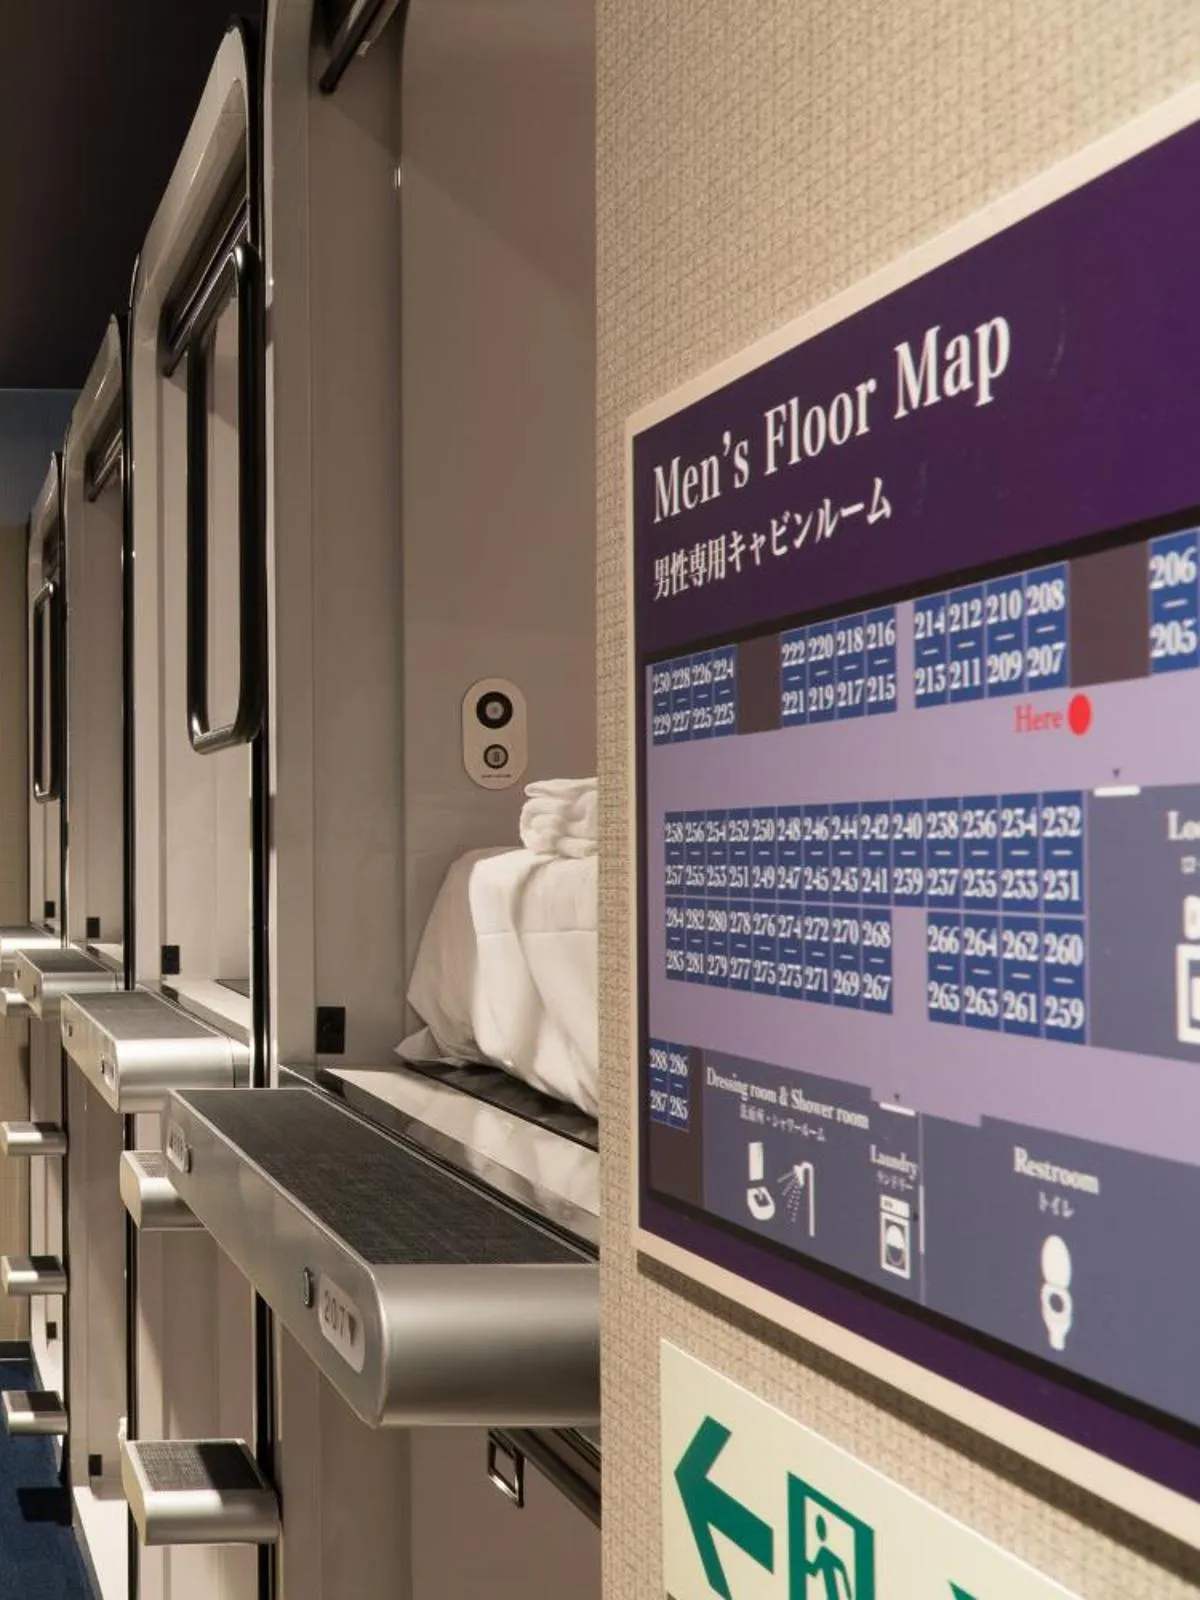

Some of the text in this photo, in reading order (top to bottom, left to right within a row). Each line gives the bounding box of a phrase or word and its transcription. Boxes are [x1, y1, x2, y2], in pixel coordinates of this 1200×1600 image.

[653, 315, 1012, 524] Men's Floor Map
[654, 476, 892, 601] 男性専用キャビンルーム
[782, 641, 805, 667] 222
[808, 635, 833, 662] 220
[837, 627, 864, 656] 218
[867, 619, 896, 649] 216
[915, 606, 945, 640] 214
[950, 599, 982, 632] 212
[986, 589, 1022, 625] 210
[1027, 579, 1065, 615] 208
[1149, 546, 1197, 590] 206
[783, 691, 804, 716] 221
[808, 685, 833, 711] 219
[838, 679, 865, 707] 217
[868, 674, 896, 702] 215
[915, 664, 946, 694] 213
[950, 658, 981, 690] 211
[987, 650, 1023, 683] 209
[1027, 643, 1066, 677] 207
[1151, 619, 1197, 658] 205
[1014, 704, 1062, 733] Here
[729, 820, 749, 843] 252
[752, 819, 774, 843] 250
[778, 817, 800, 841] 248
[804, 816, 828, 841] 246
[832, 815, 859, 841] 244
[862, 814, 889, 840] 242
[892, 813, 922, 840] 240
[927, 811, 958, 839] 238
[962, 810, 997, 838] 236
[1002, 807, 1038, 838] 234
[1042, 806, 1081, 837] 232
[729, 866, 749, 888] 251
[753, 866, 774, 888] 249
[778, 867, 800, 889] 247
[805, 867, 828, 891] 245
[832, 867, 859, 892] 243
[862, 868, 888, 893] 241
[894, 868, 922, 894] 239
[928, 868, 958, 896] 237
[964, 868, 997, 898] 235
[1002, 869, 1038, 900] 233
[1044, 869, 1080, 901] 231
[730, 912, 751, 935] 278
[753, 913, 775, 936] 276
[779, 914, 802, 939] 274
[805, 917, 829, 942] 272
[833, 919, 859, 945] 270
[863, 921, 890, 947] 268
[928, 925, 960, 955] 266
[964, 927, 997, 957] 264
[1002, 930, 1038, 962] 262
[1044, 934, 1082, 966] 260
[707, 955, 727, 977] 279
[730, 957, 751, 980] 277
[753, 960, 776, 984] 275
[779, 962, 802, 988] 273
[805, 966, 828, 992] 271
[833, 969, 859, 996] 269
[863, 973, 891, 1000] 267
[928, 981, 960, 1012] 265
[964, 984, 998, 1016] 263
[1002, 990, 1038, 1024] 261
[1045, 994, 1084, 1030] 259
[707, 1067, 869, 1130] Dressing room & Shower room
[870, 1144, 918, 1177] Laundry
[1014, 1146, 1099, 1195] Restroom
